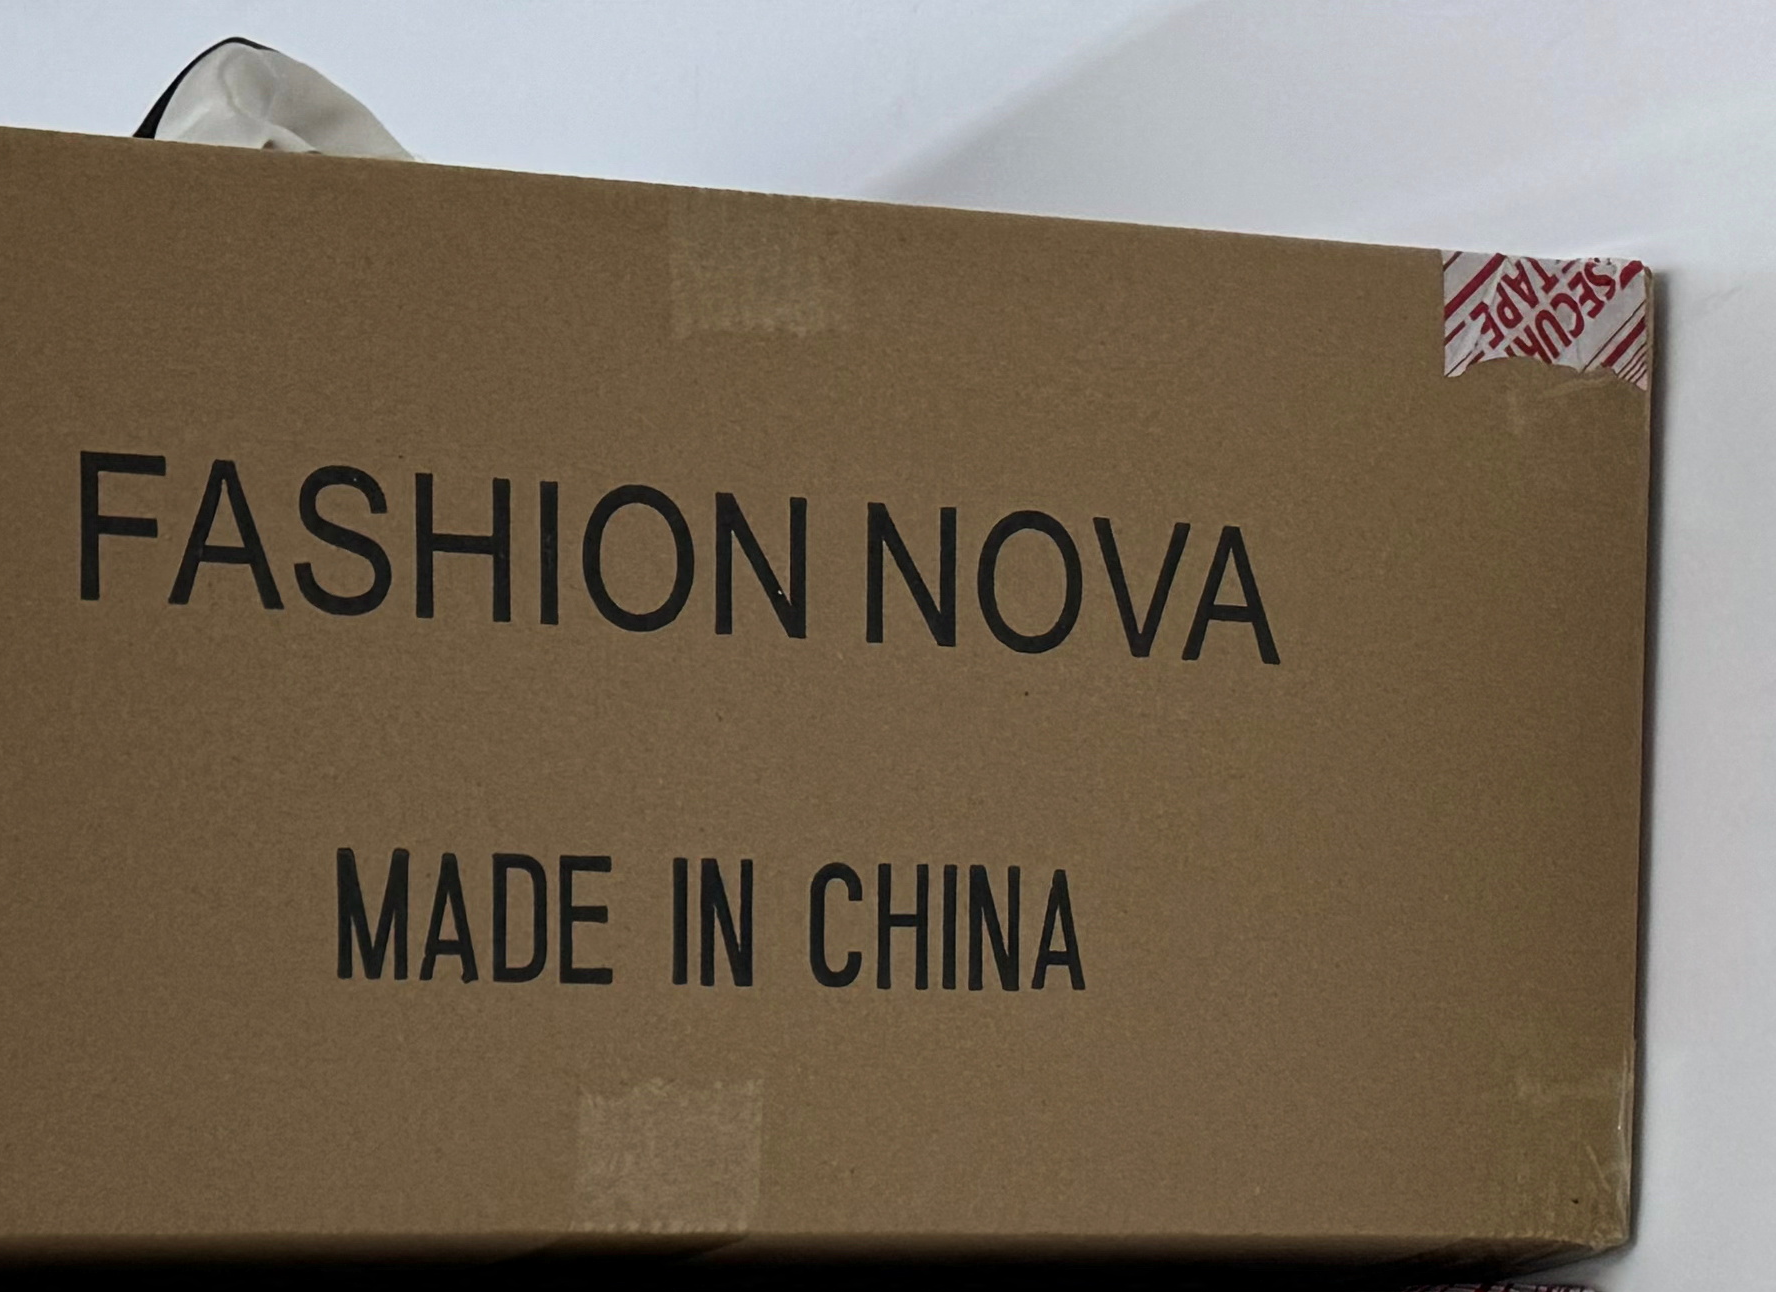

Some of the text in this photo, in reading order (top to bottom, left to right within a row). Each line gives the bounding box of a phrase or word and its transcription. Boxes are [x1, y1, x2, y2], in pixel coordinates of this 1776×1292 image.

[1469, 256, 1560, 350] TAPE
[80, 451, 1280, 666] FASHION NOVA
[337, 848, 1085, 992] MADE IN CHINA
